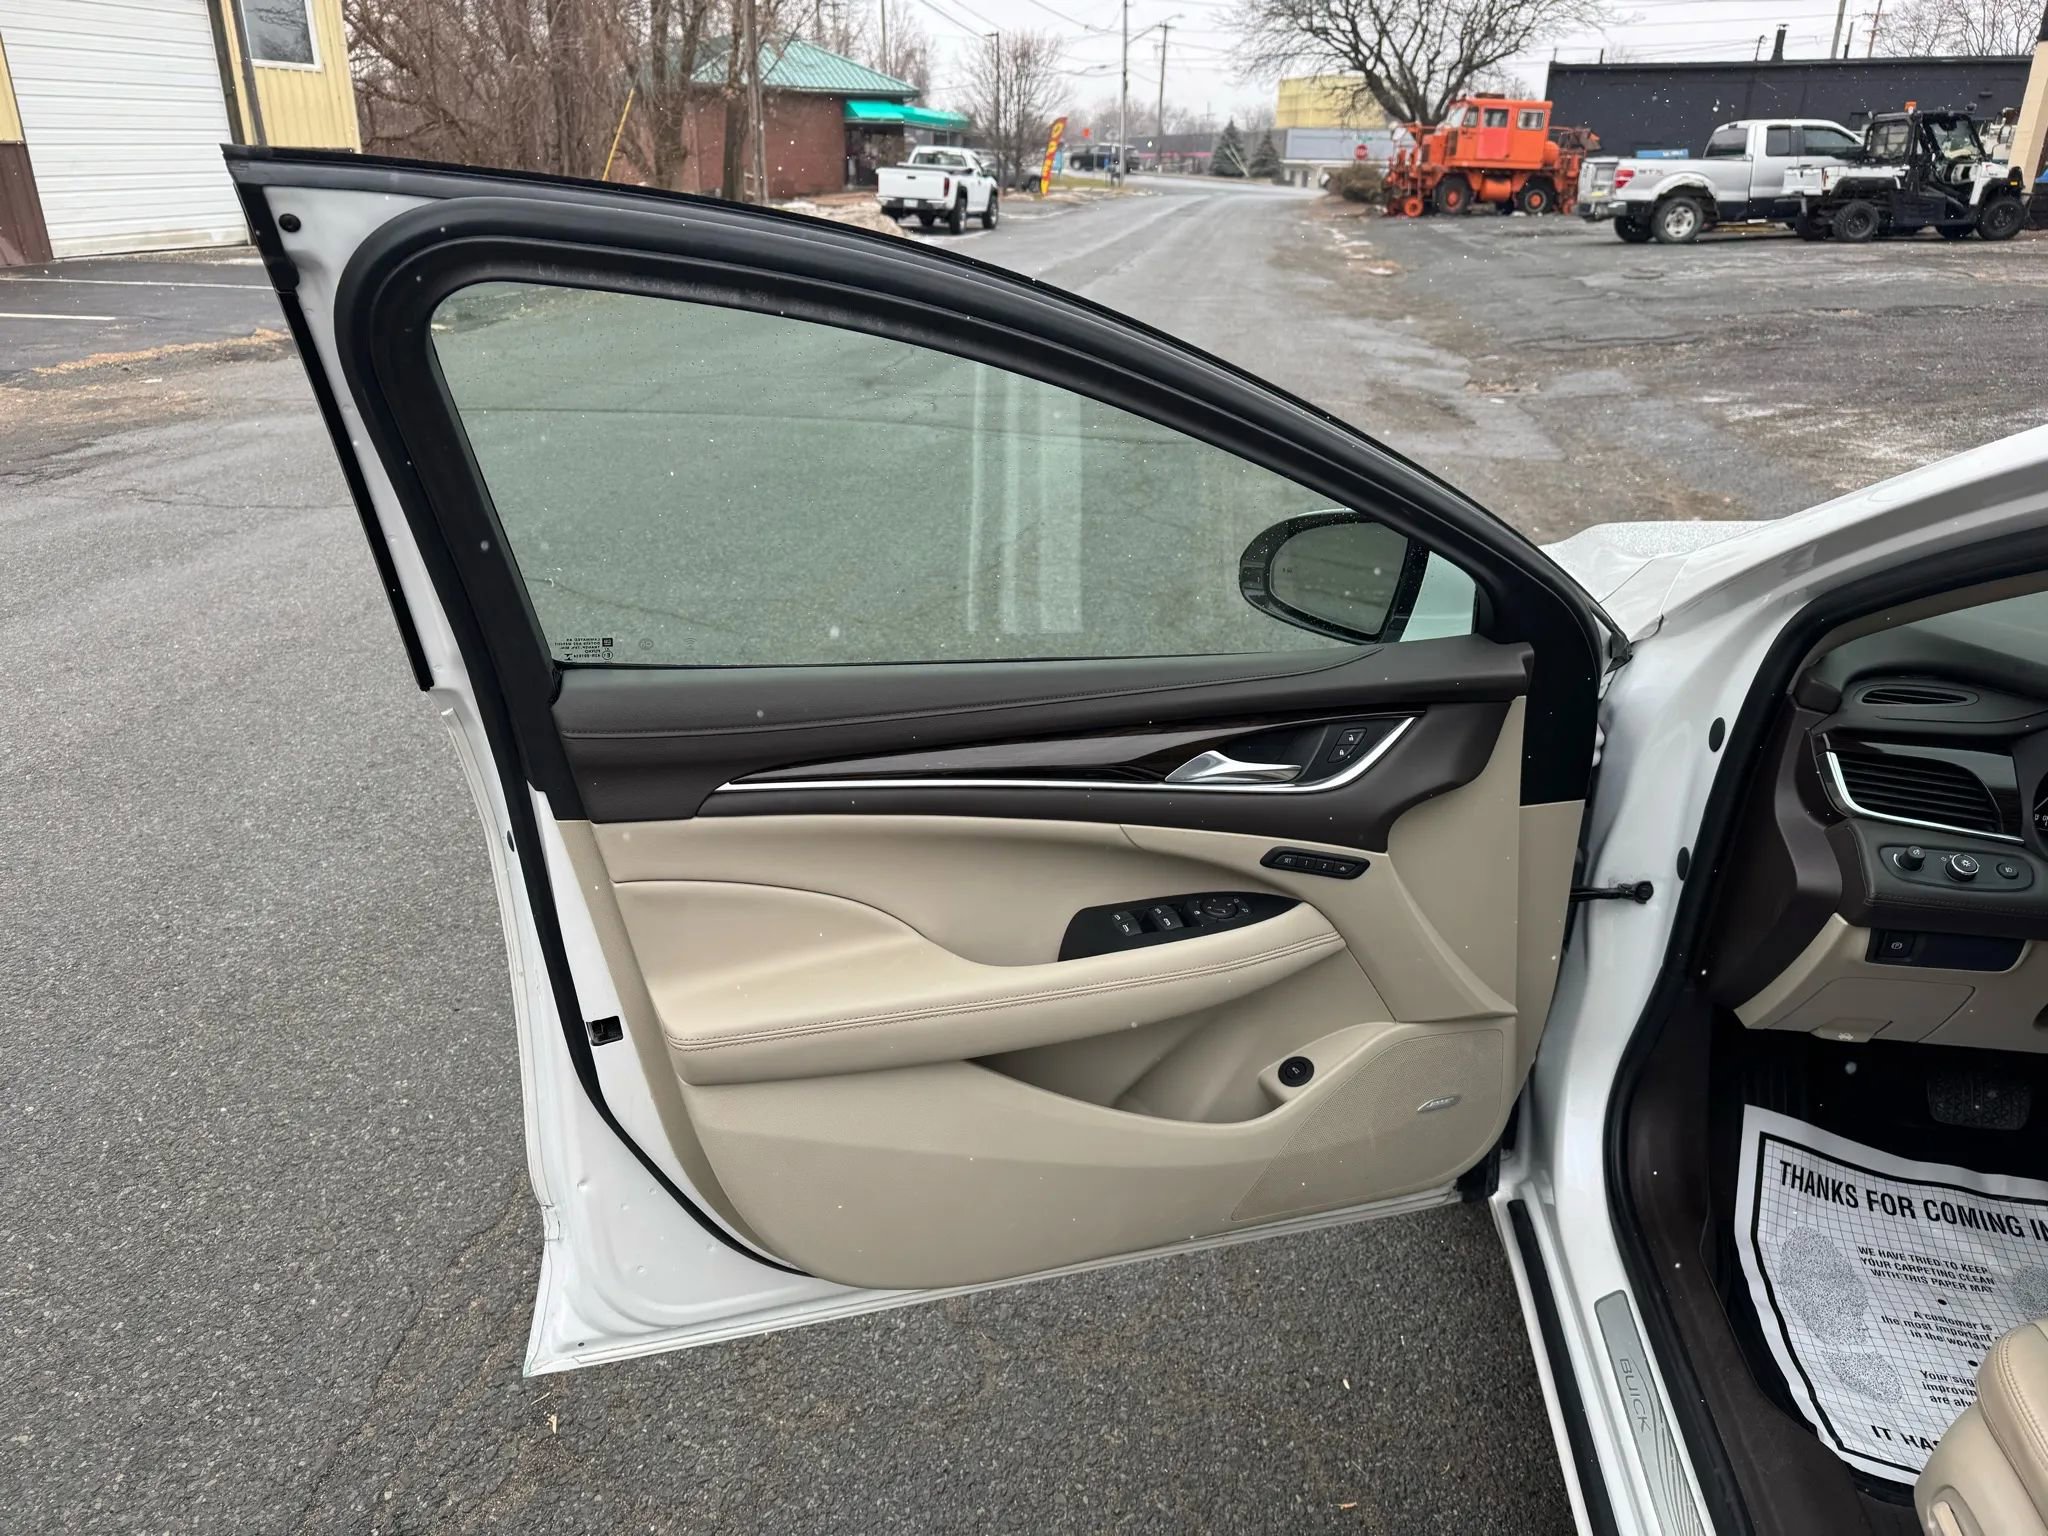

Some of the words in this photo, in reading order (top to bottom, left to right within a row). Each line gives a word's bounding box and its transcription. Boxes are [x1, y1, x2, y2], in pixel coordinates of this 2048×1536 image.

[1780, 1160, 1859, 1209] THANKS
[1866, 1189, 1917, 1220] FOR
[1923, 1199, 2026, 1238] COMING
[1858, 1245, 1876, 1256] WE
[1878, 1249, 1906, 1262] HAVE
[1908, 1254, 1941, 1267] TRIED
[1943, 1260, 1958, 1270] TO
[1961, 1263, 1988, 1275] KEEP
[1861, 1257, 1892, 1270] YOUR
[1894, 1262, 1957, 1280] CARPETING
[1959, 1272, 1995, 1286] CLEAN
[1871, 1268, 1901, 1280] WITH
[1902, 1272, 1929, 1285] THIS
[1931, 1278, 1968, 1292] PAPER
[1970, 1284, 1994, 1294] MAT
[1881, 1315, 1901, 1326] the
[1903, 1320, 1933, 1332] most
[1936, 1324, 1993, 1343] important
[1914, 1311, 1922, 1319] A
[1925, 1314, 1978, 1328] customer
[1980, 1322, 1993, 1332] is
[1925, 1332, 1944, 1343] the
[1946, 1337, 1981, 1350] world
[1920, 1370, 1949, 1382] Your
[1620, 1358, 1651, 1432] BUICK
[1929, 1395, 1950, 1405] are
[1871, 1425, 1893, 1441] IT
